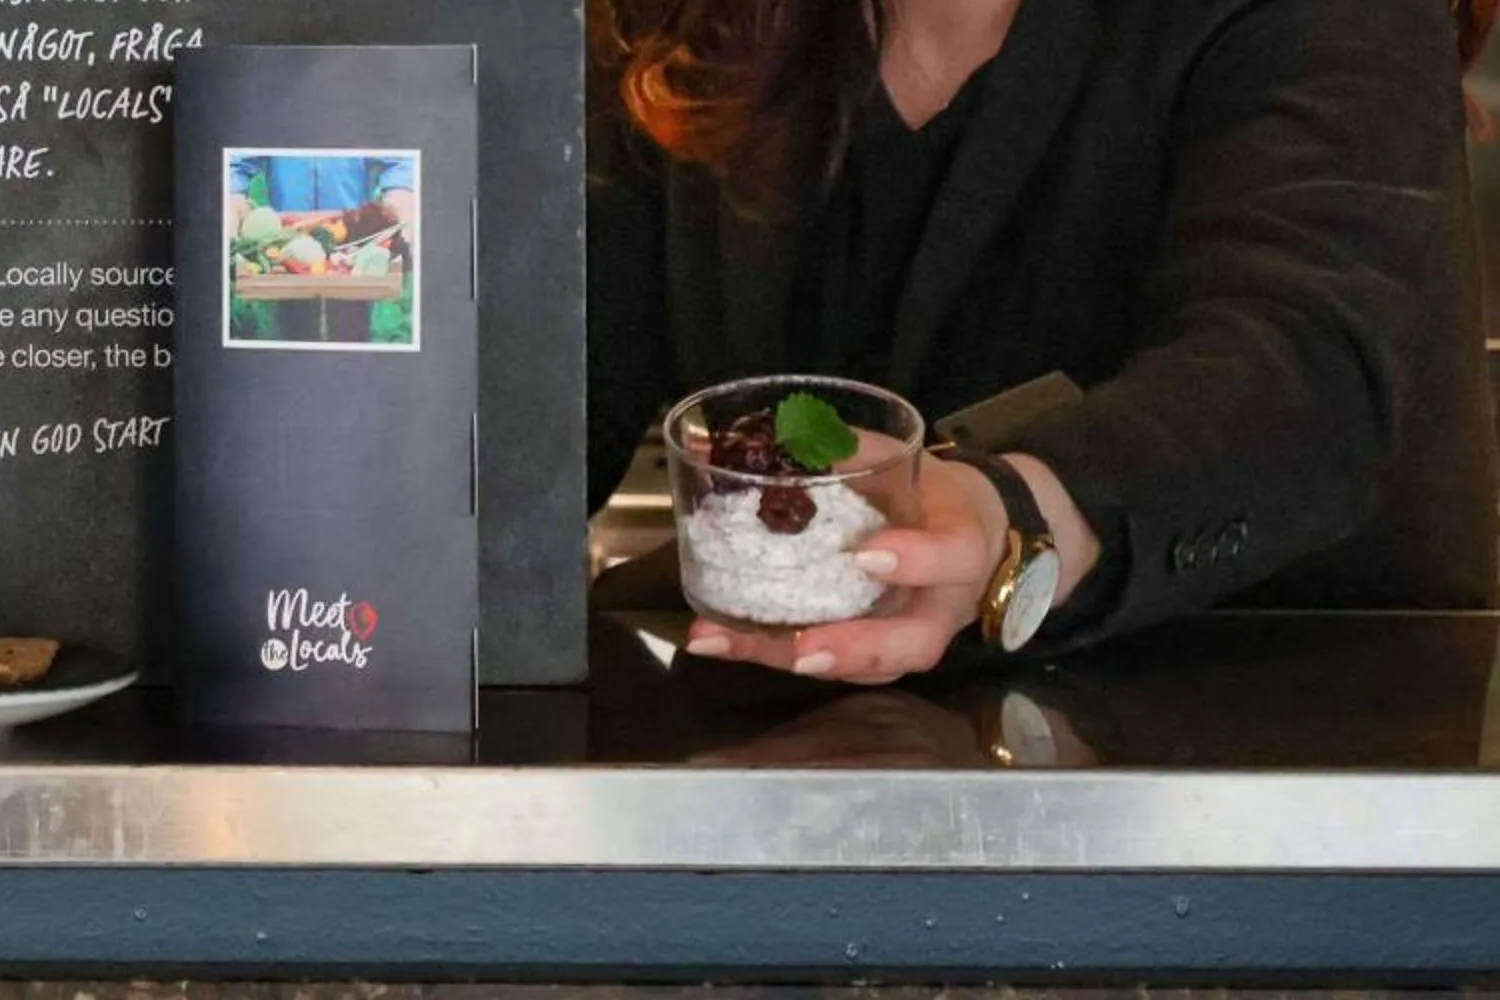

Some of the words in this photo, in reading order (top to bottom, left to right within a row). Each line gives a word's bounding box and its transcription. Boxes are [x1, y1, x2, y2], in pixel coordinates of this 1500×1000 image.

[21, 308, 69, 333] any
[11, 343, 98, 372] closer,
[104, 343, 148, 368] the
[32, 423, 82, 456] GOD
[93, 416, 171, 454] START
[267, 588, 352, 631] Meet
[290, 629, 373, 671] Locals
